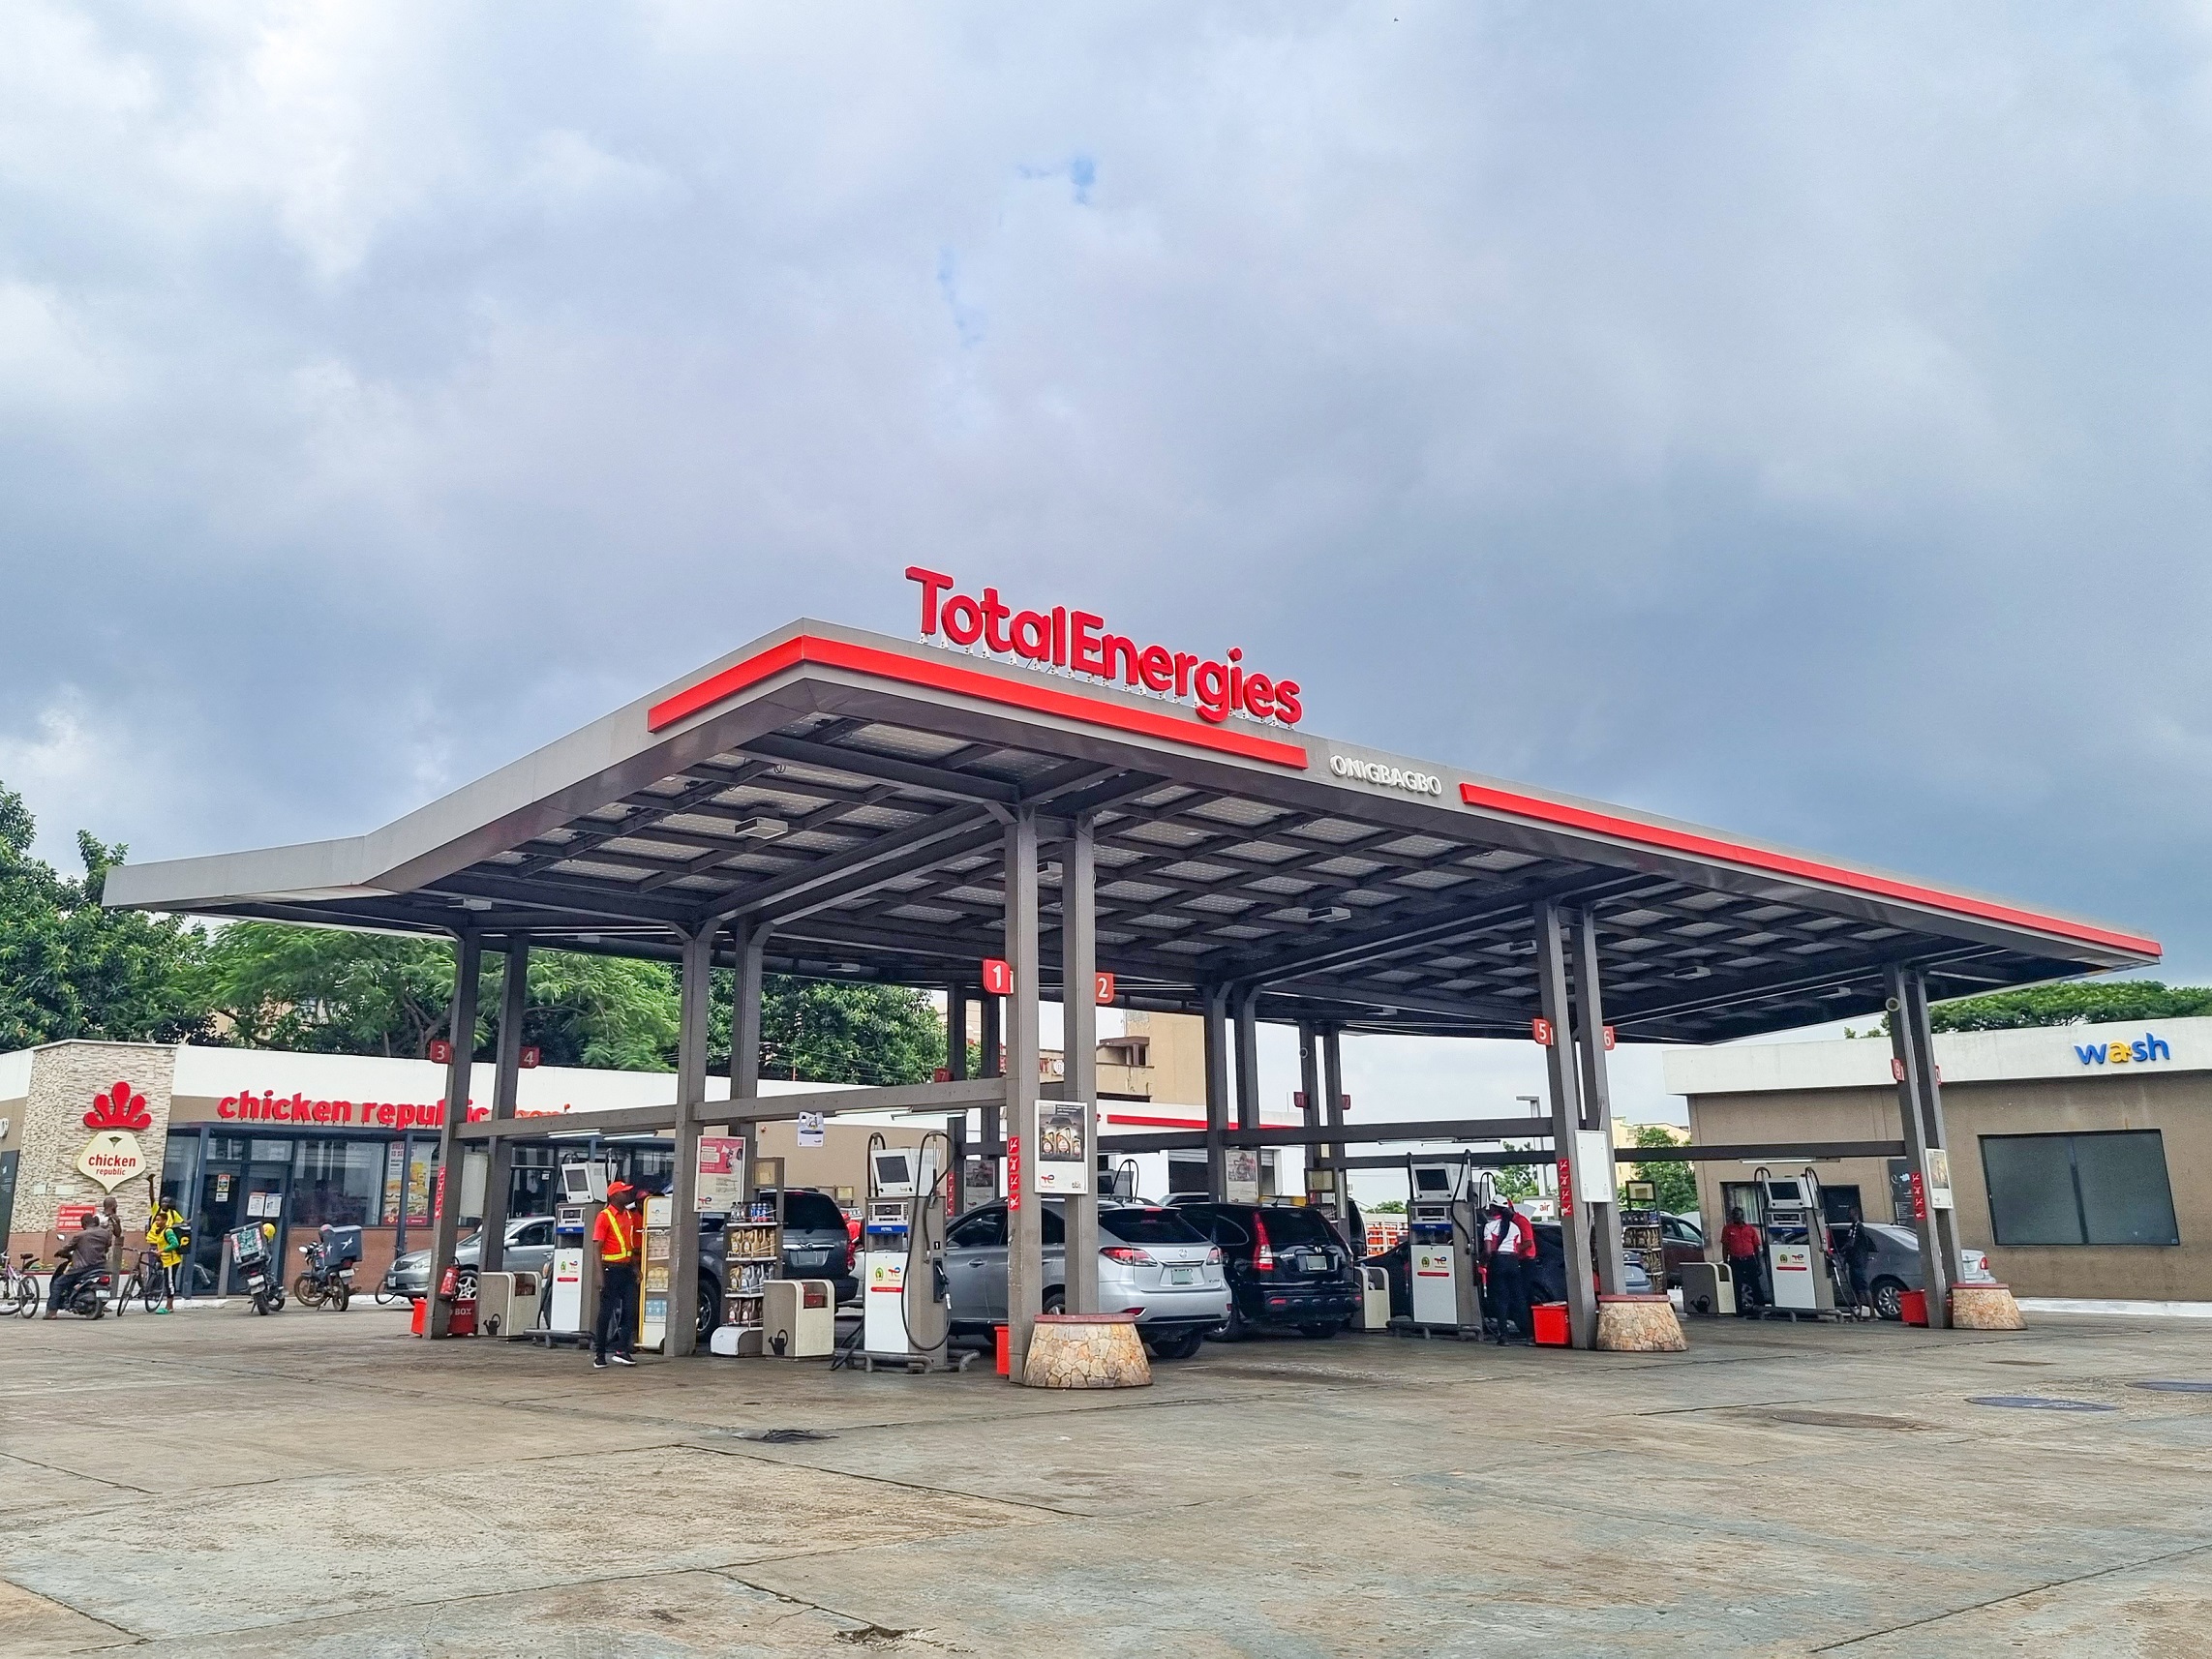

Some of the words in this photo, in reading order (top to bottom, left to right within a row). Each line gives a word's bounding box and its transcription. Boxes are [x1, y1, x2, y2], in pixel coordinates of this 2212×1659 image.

[905, 565, 1304, 724] TotalEnergies
[1329, 755, 1442, 796] ONIGBAGBO
[992, 964, 1002, 989] 1
[1098, 977, 1109, 998] 2
[1538, 1023, 1548, 1041] 5
[1603, 1030, 1612, 1046] 6
[437, 1044, 446, 1061] 3
[523, 1050, 534, 1065] 4
[2074, 1032, 2170, 1065] wash
[217, 1089, 352, 1123] chicken
[88, 1154, 136, 1167] chicken
[96, 1167, 127, 1177] republic
[1539, 1201, 1551, 1212] air
